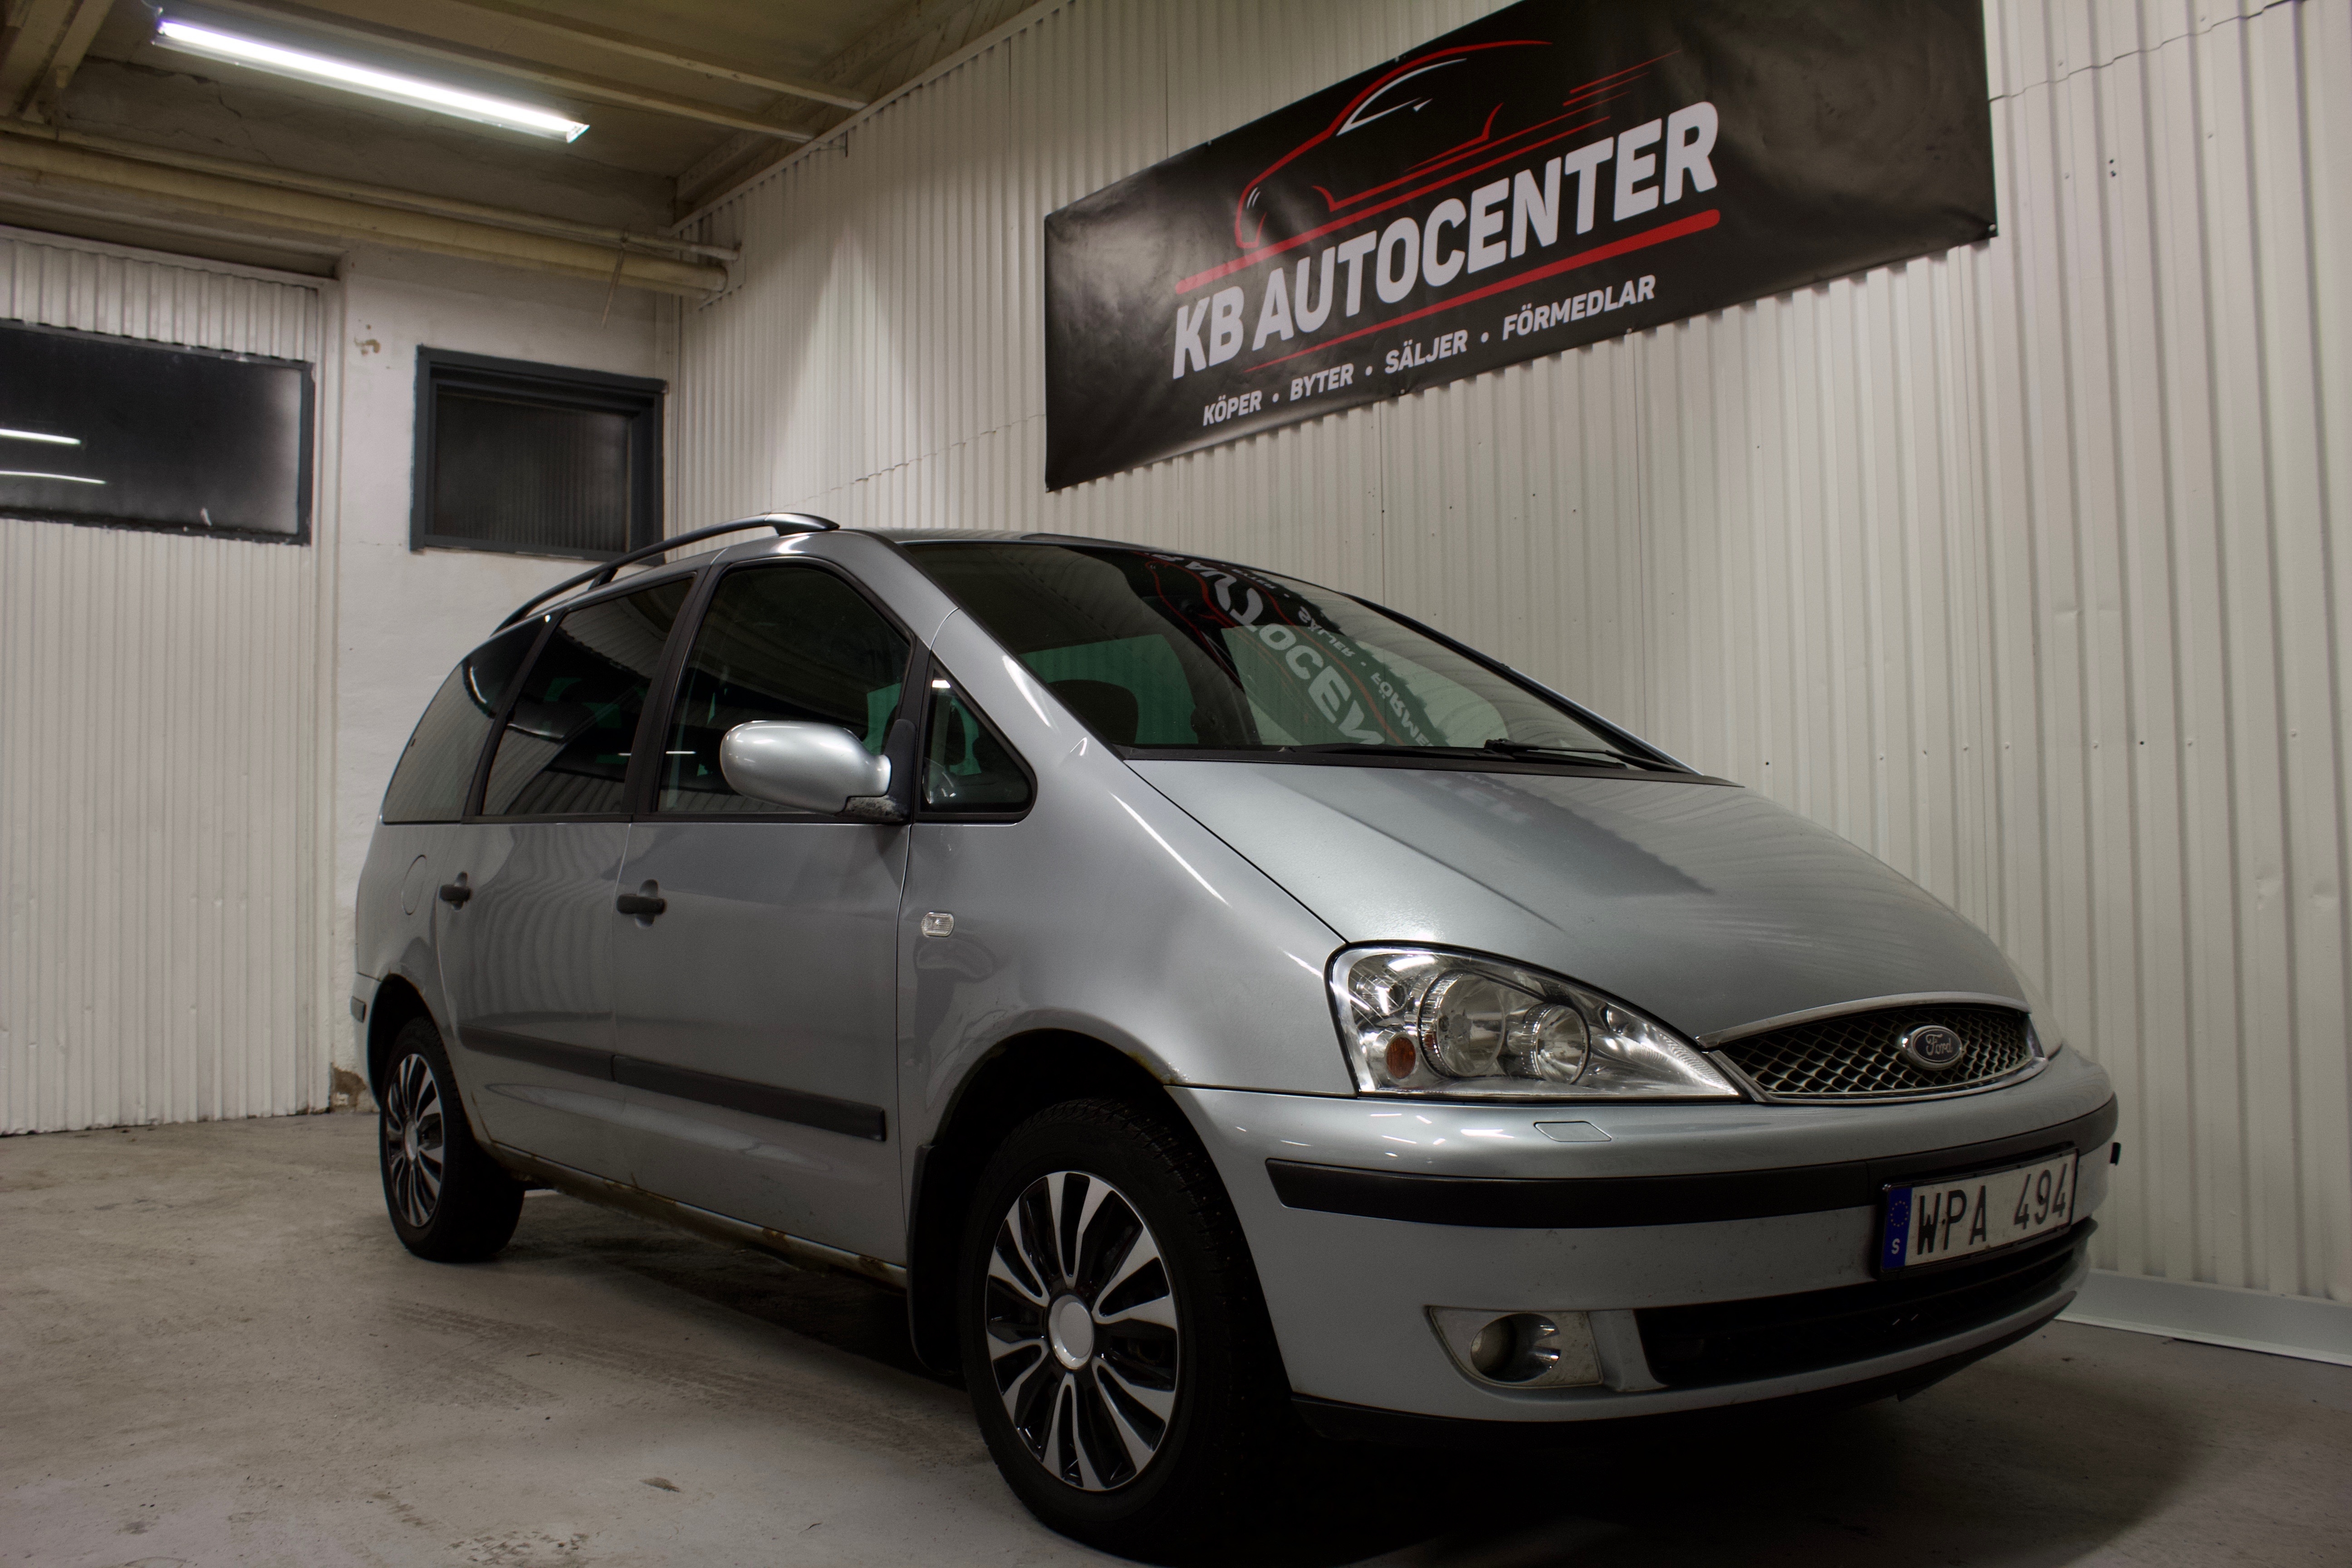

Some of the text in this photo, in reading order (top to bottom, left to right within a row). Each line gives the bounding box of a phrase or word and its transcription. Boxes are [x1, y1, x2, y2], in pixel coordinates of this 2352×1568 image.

[1173, 102, 1719, 379] KB AUTOCENTER
[1203, 275, 1656, 426] KÖPER BYTER SÄLJER FÖRMEDLAR
[1925, 1034, 1952, 1056] Ford
[1891, 1238, 1901, 1255] S
[1917, 1163, 2068, 1255] WPA 494
